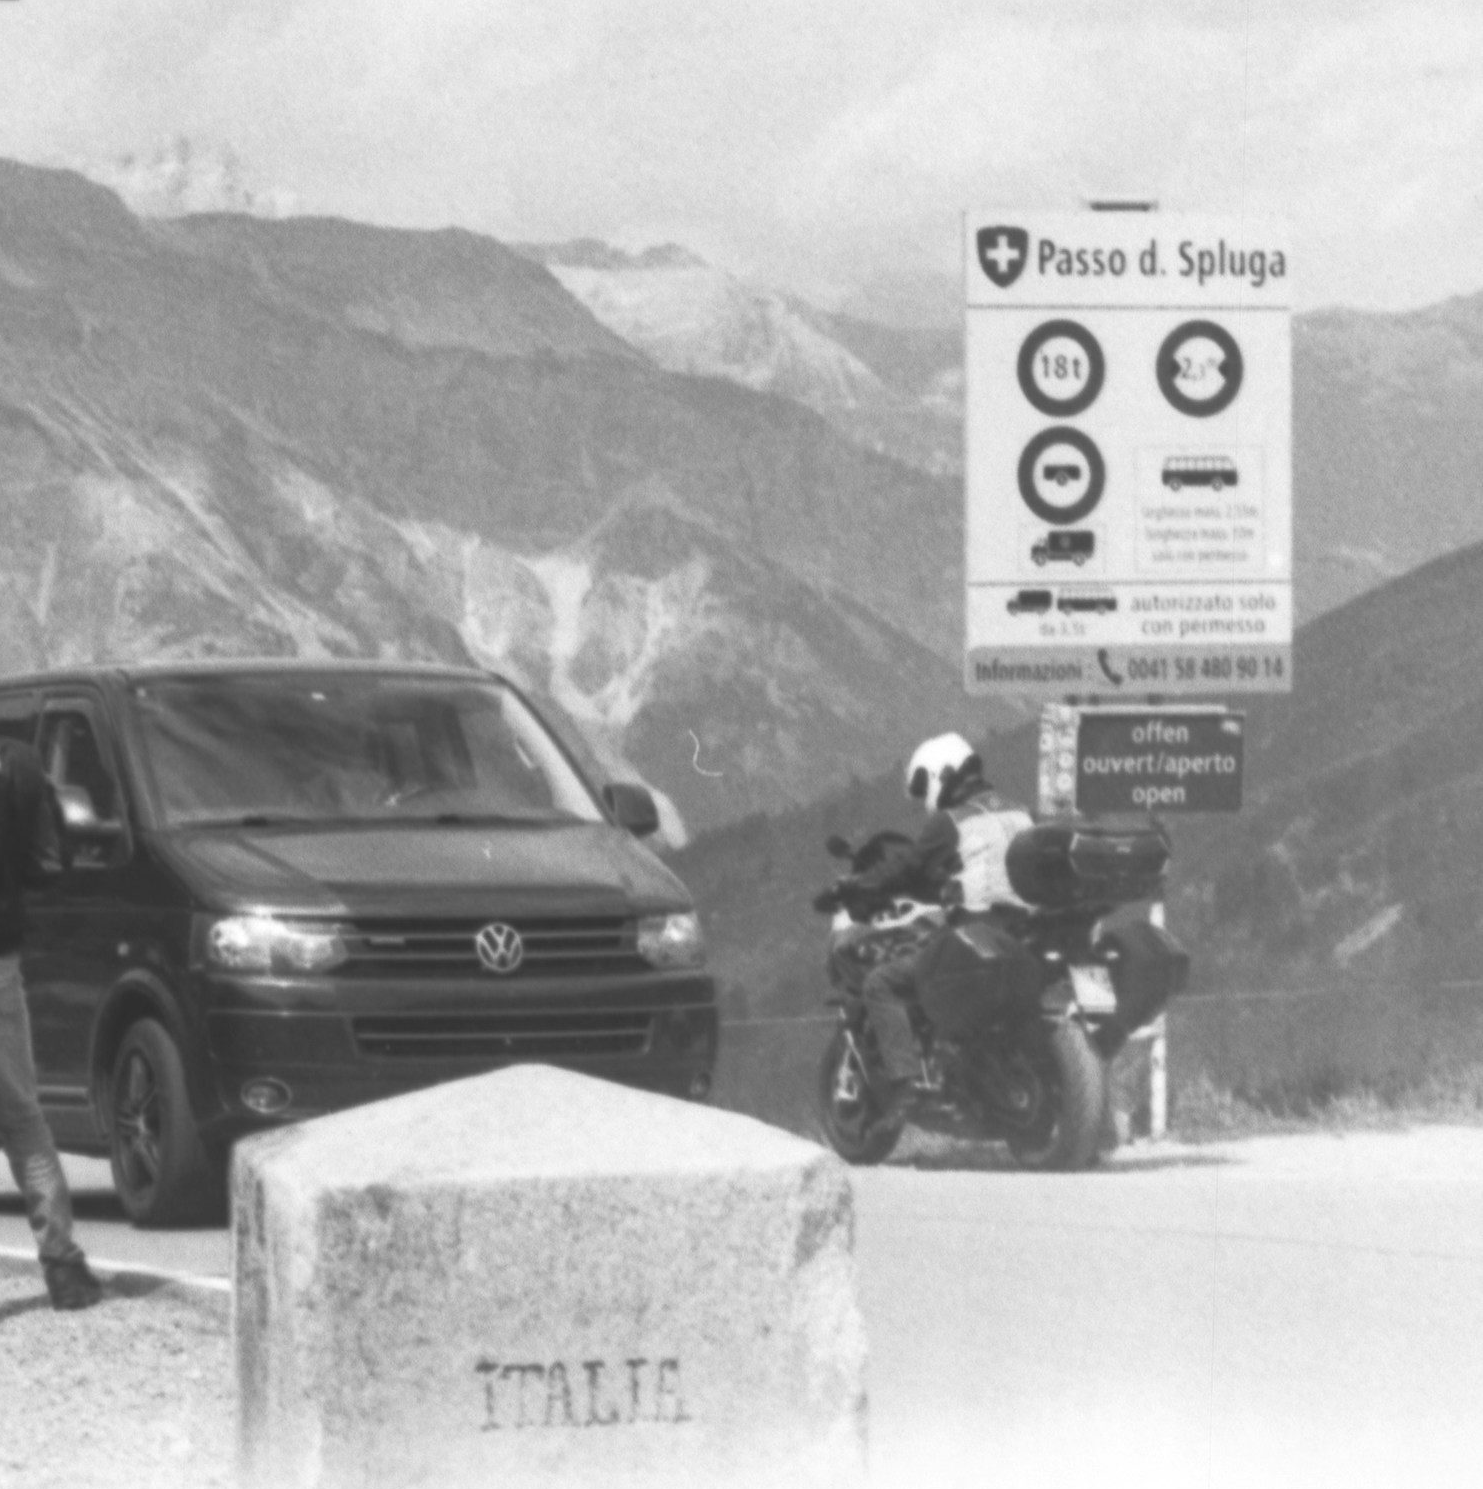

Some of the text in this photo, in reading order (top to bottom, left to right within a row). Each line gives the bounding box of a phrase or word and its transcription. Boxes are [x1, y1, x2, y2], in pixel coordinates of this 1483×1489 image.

[1038, 238, 1287, 288] Passo d. Spluga
[1130, 592, 1276, 612] autorizzato solo
[1140, 618, 1267, 638] con permesso
[975, 654, 1284, 682] Informazioni 0041 58 480 90 14
[1131, 722, 1189, 744] offen
[1082, 752, 1237, 779] ouvert/aperto
[1131, 785, 1187, 809] open
[474, 1357, 694, 1432] ITALIA
